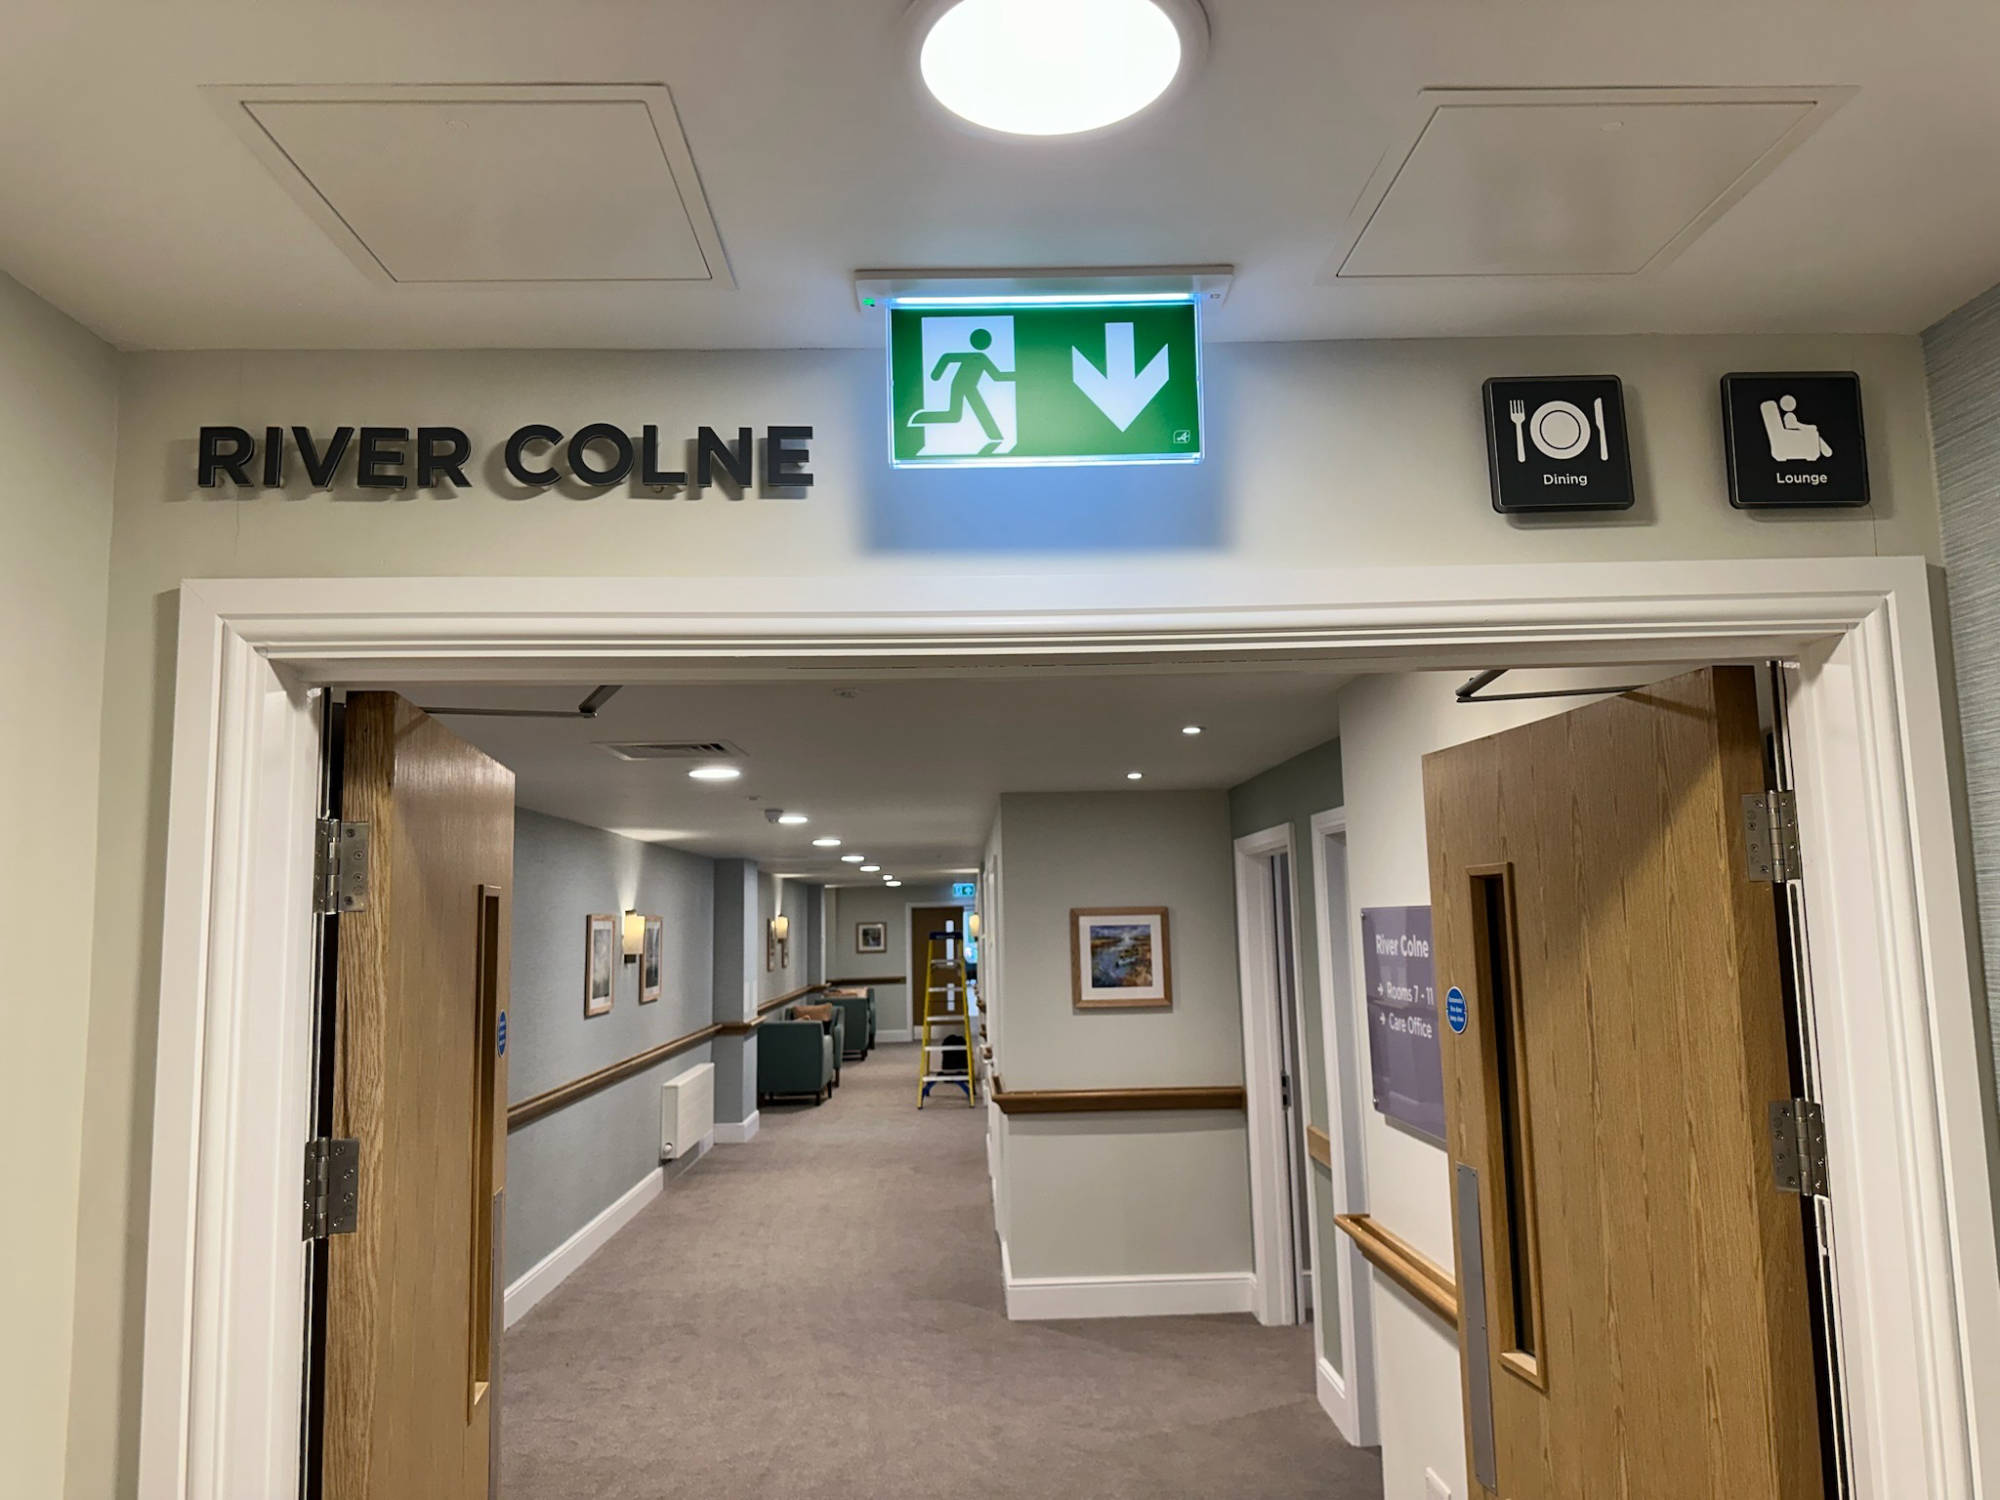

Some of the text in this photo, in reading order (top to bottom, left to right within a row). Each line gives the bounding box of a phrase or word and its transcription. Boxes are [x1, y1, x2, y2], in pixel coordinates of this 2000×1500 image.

[197, 422, 814, 488] RIVER COLNE
[1543, 473, 1588, 487] Dining
[1776, 472, 1828, 486] Lounge
[1375, 934, 1429, 958] River Colne
[1386, 981, 1413, 1002] Rooms
[1413, 985, 1419, 1003] 7
[1388, 1012, 1433, 1039] Care Office
